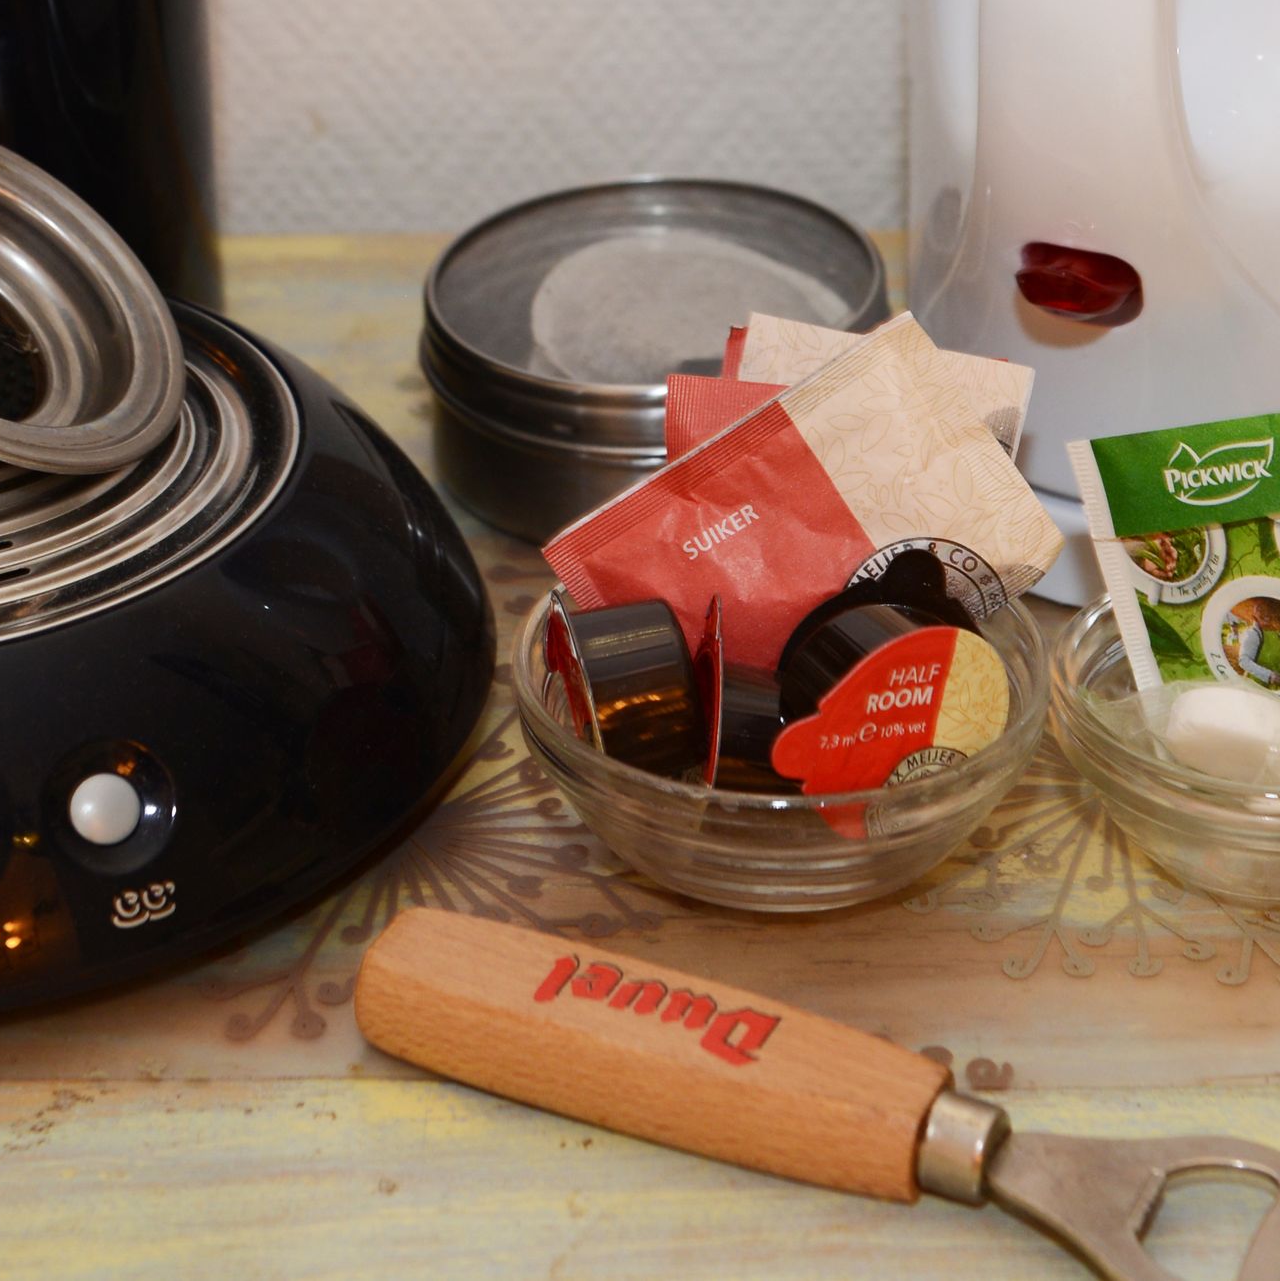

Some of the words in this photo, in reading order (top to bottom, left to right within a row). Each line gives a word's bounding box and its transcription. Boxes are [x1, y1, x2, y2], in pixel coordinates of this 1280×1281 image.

[1164, 460, 1272, 493] PICKWICK
[683, 504, 760, 560] SUIKER
[928, 541, 938, 554] &
[949, 548, 978, 572] CO
[890, 663, 941, 687] HALF
[866, 685, 934, 715] ROOM
[880, 722, 905, 738] 10%
[908, 721, 927, 734] vet
[906, 749, 956, 771] MEIJER
[533, 954, 782, 1066] Duvel
